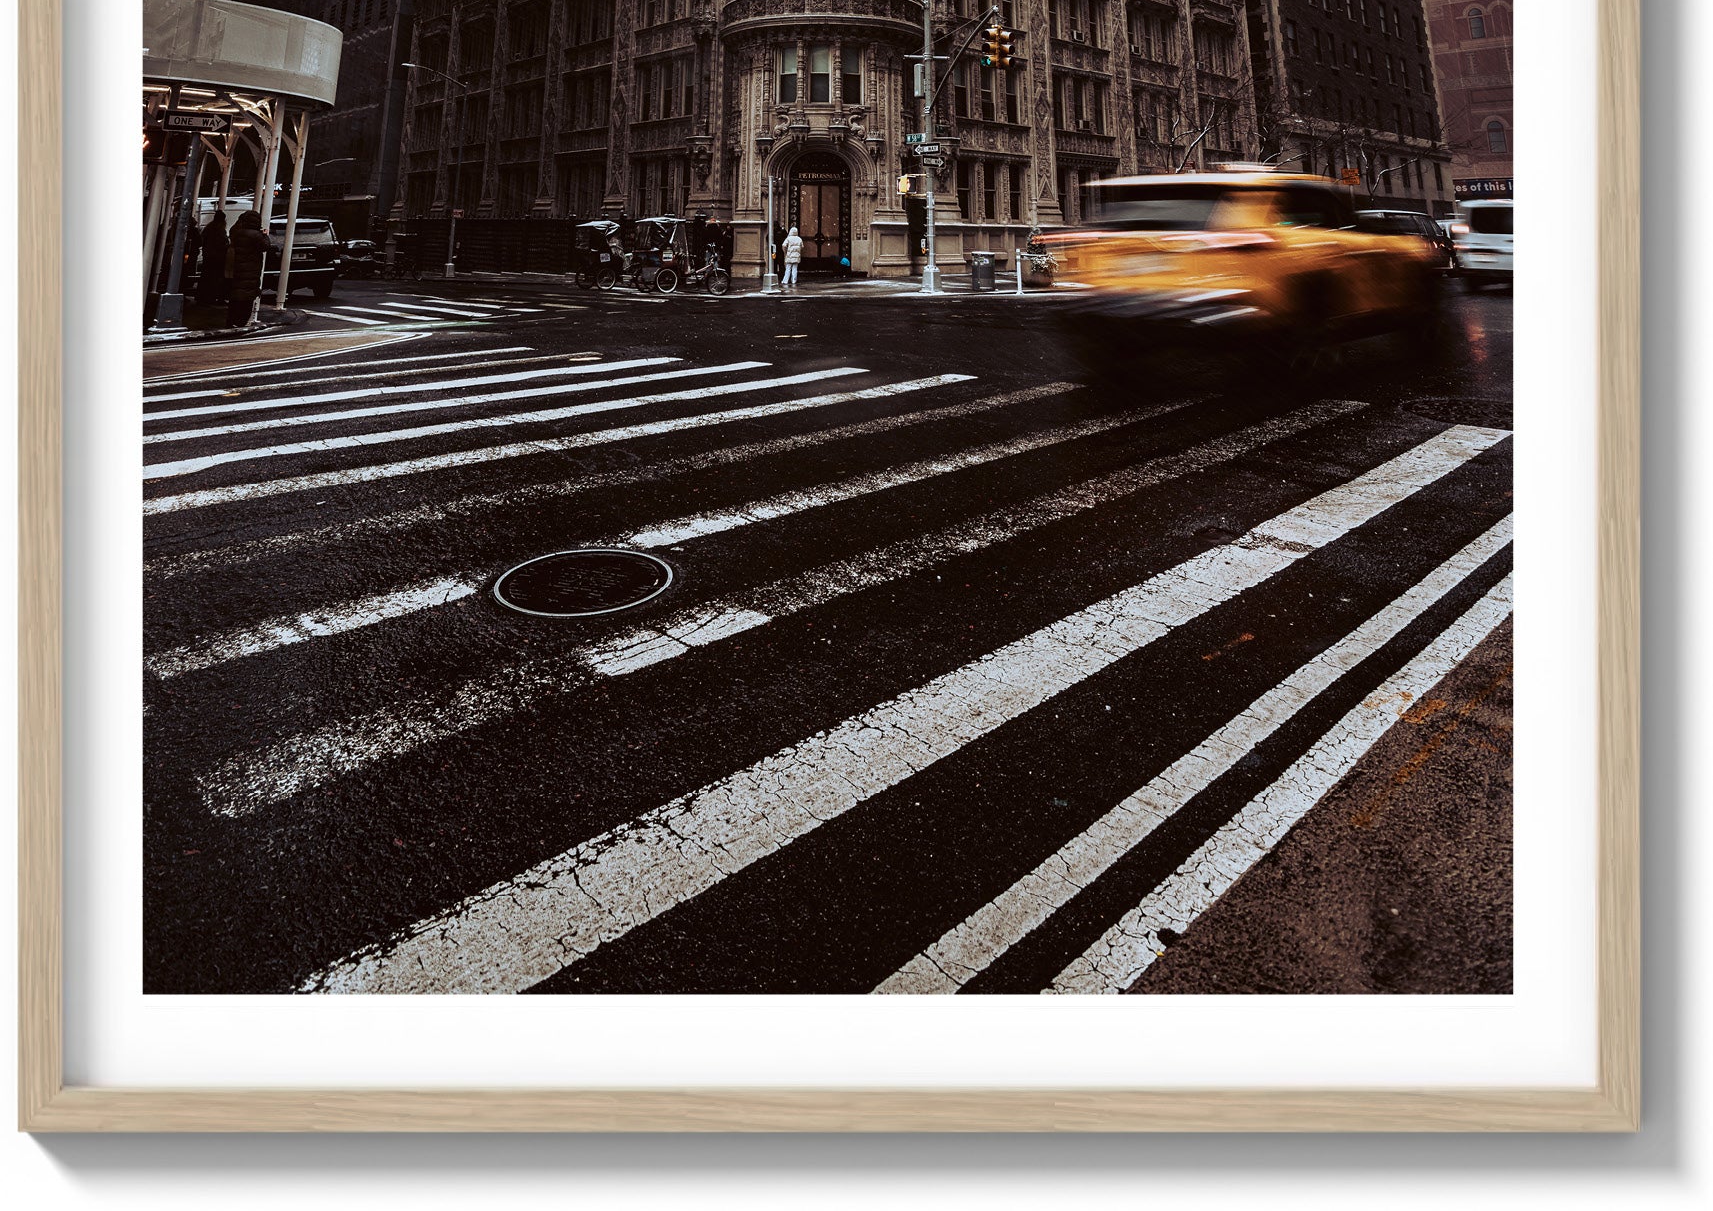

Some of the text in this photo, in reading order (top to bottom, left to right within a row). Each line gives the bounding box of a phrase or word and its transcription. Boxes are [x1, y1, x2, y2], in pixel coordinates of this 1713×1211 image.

[174, 116, 222, 127] ONE WAY
[1470, 182, 1481, 191] of
[1484, 181, 1506, 191] this
